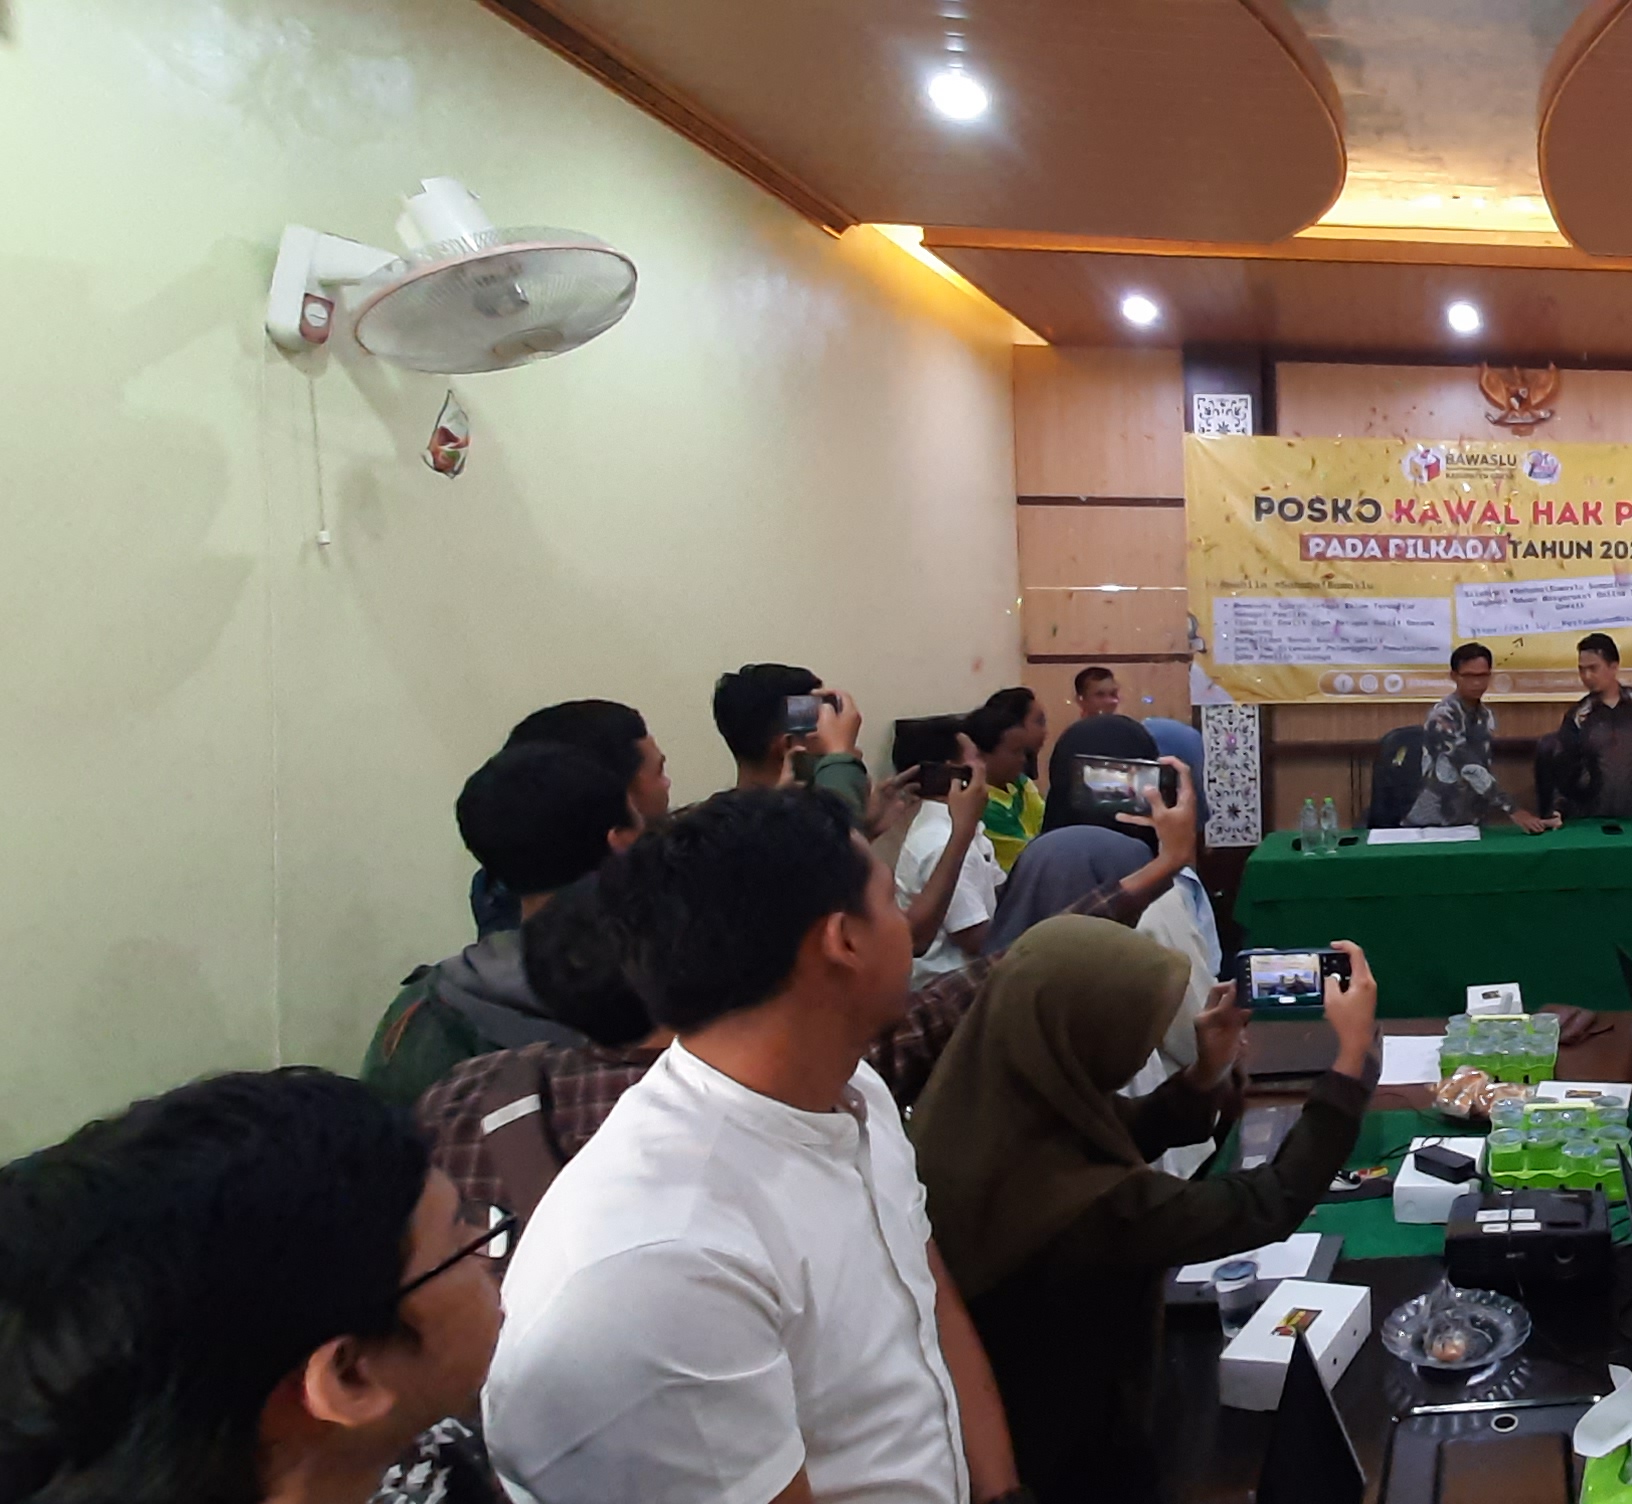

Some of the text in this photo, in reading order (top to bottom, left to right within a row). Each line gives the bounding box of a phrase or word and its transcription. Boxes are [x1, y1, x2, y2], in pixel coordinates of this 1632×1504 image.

[1446, 453, 1517, 467] BAWASLU
[1254, 494, 1383, 524] POSKO
[1394, 498, 1520, 526] KAWAL
[1532, 500, 1603, 526] HAK
[1308, 537, 1382, 558] PADA
[1389, 537, 1503, 560] PILKADA
[1508, 540, 1593, 559] TAHUN
